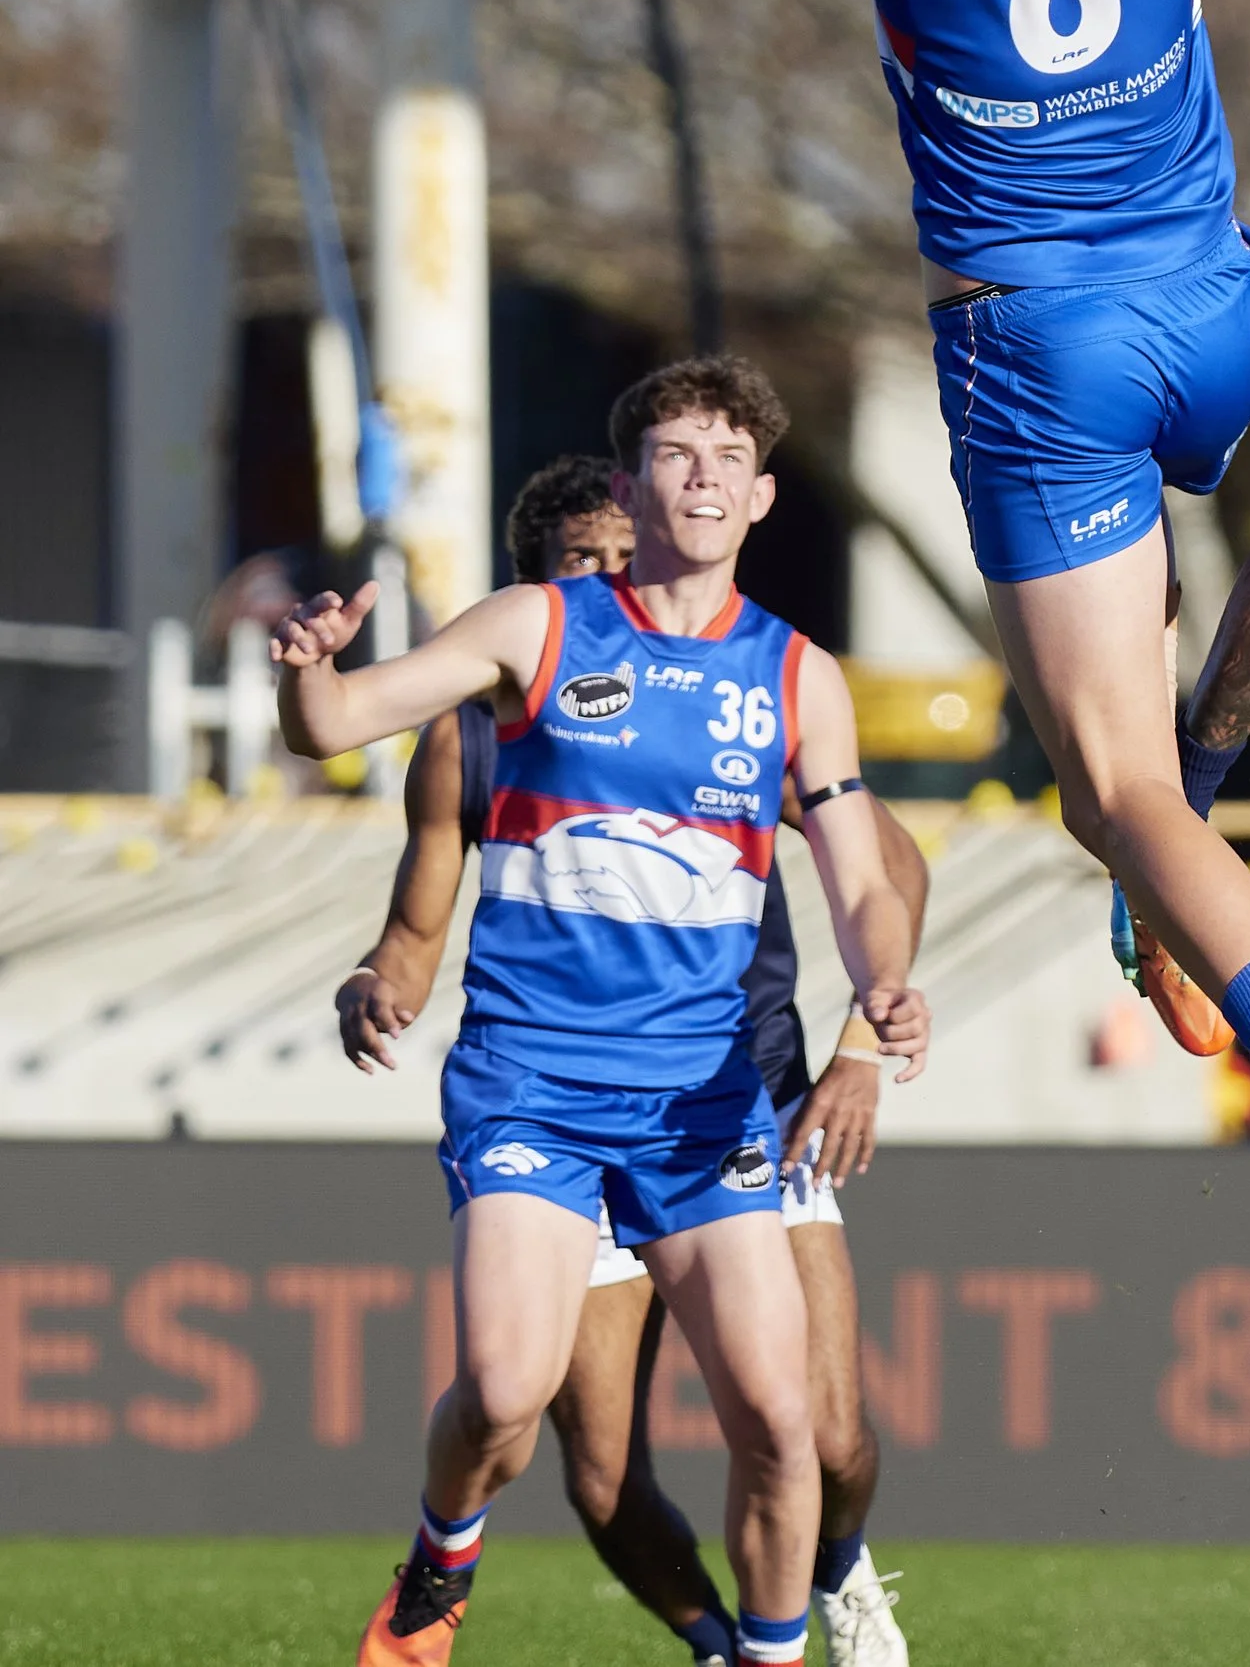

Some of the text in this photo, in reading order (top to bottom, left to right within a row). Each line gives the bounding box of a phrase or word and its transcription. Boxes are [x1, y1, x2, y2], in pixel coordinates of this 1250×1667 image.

[1044, 29, 1186, 110] WAYNE MANION
[1052, 47, 1090, 64] LRF
[1045, 90, 1138, 124] PLUMBING
[1070, 497, 1129, 535] LRF
[1073, 514, 1129, 542] SPORT
[645, 665, 705, 684] LRF
[580, 691, 629, 716] NTFA
[707, 679, 777, 749] 36
